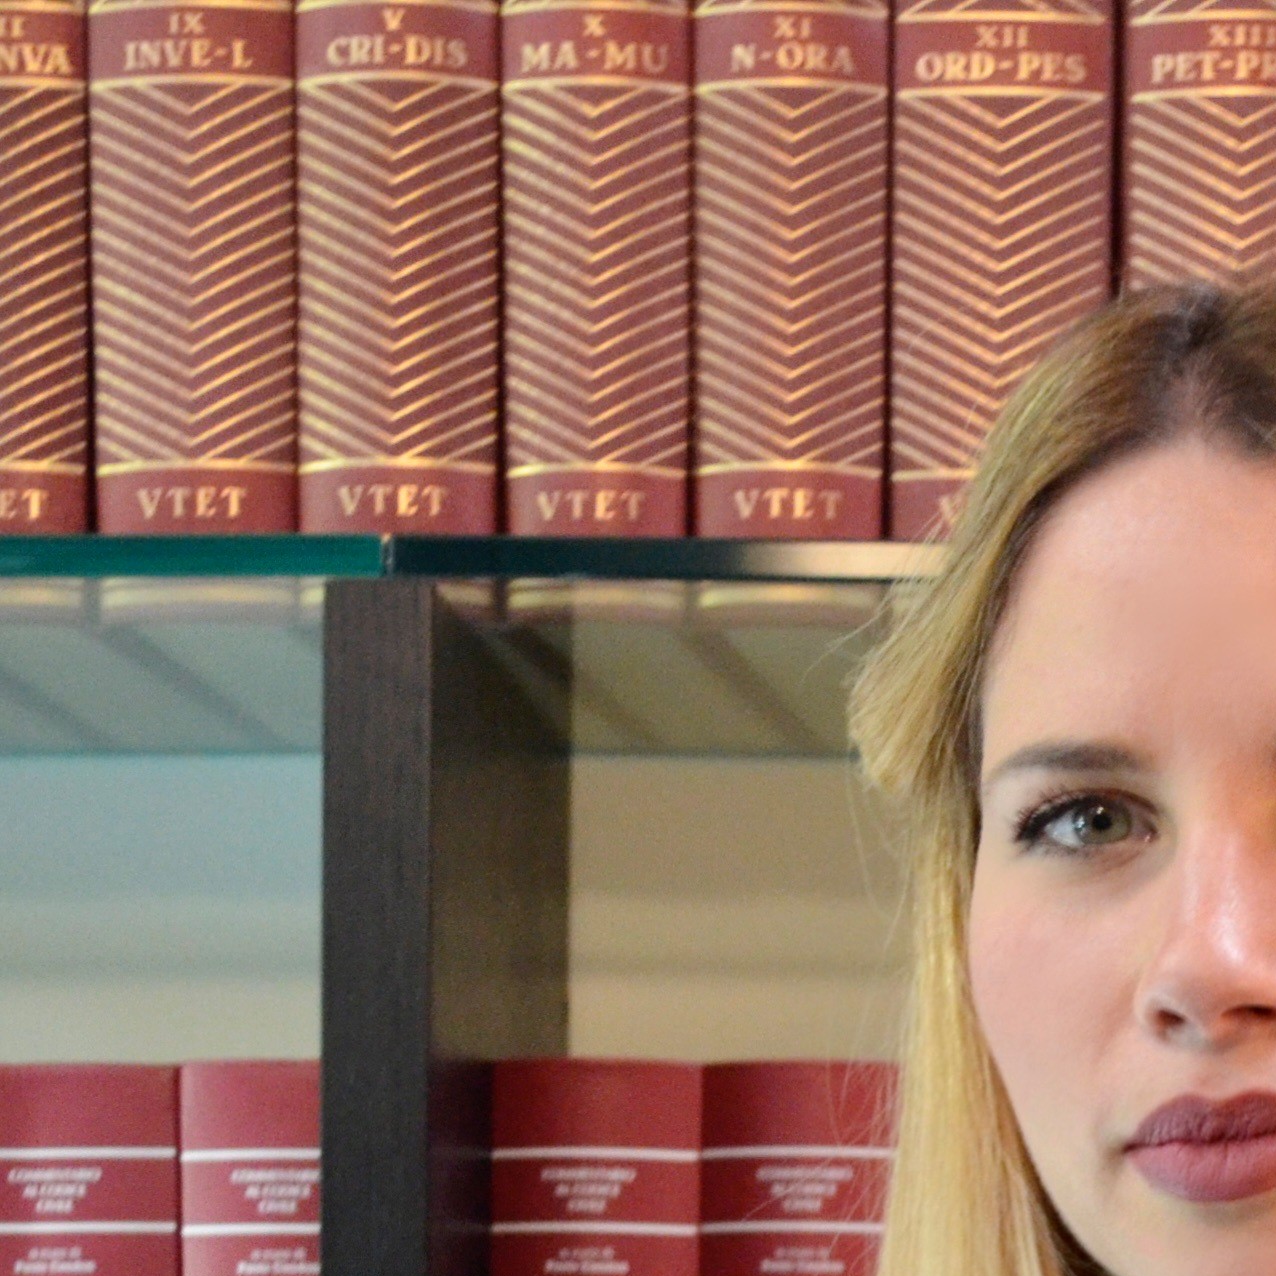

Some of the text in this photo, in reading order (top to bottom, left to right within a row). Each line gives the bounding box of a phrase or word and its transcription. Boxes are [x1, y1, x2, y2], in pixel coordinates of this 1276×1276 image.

[168, 12, 205, 35] IX
[383, 9, 406, 31] V
[583, 14, 606, 37] X
[773, 15, 812, 39] XI
[326, 33, 468, 68] CRI-DIS
[975, 25, 1029, 48] XII
[123, 38, 253, 71] INVE-L
[730, 42, 855, 75] N-ORA
[915, 51, 1087, 83] ORD-PES
[137, 486, 247, 520] VTET
[337, 483, 446, 517] VTET
[537, 490, 646, 522] VTET
[733, 488, 844, 521] VTET
